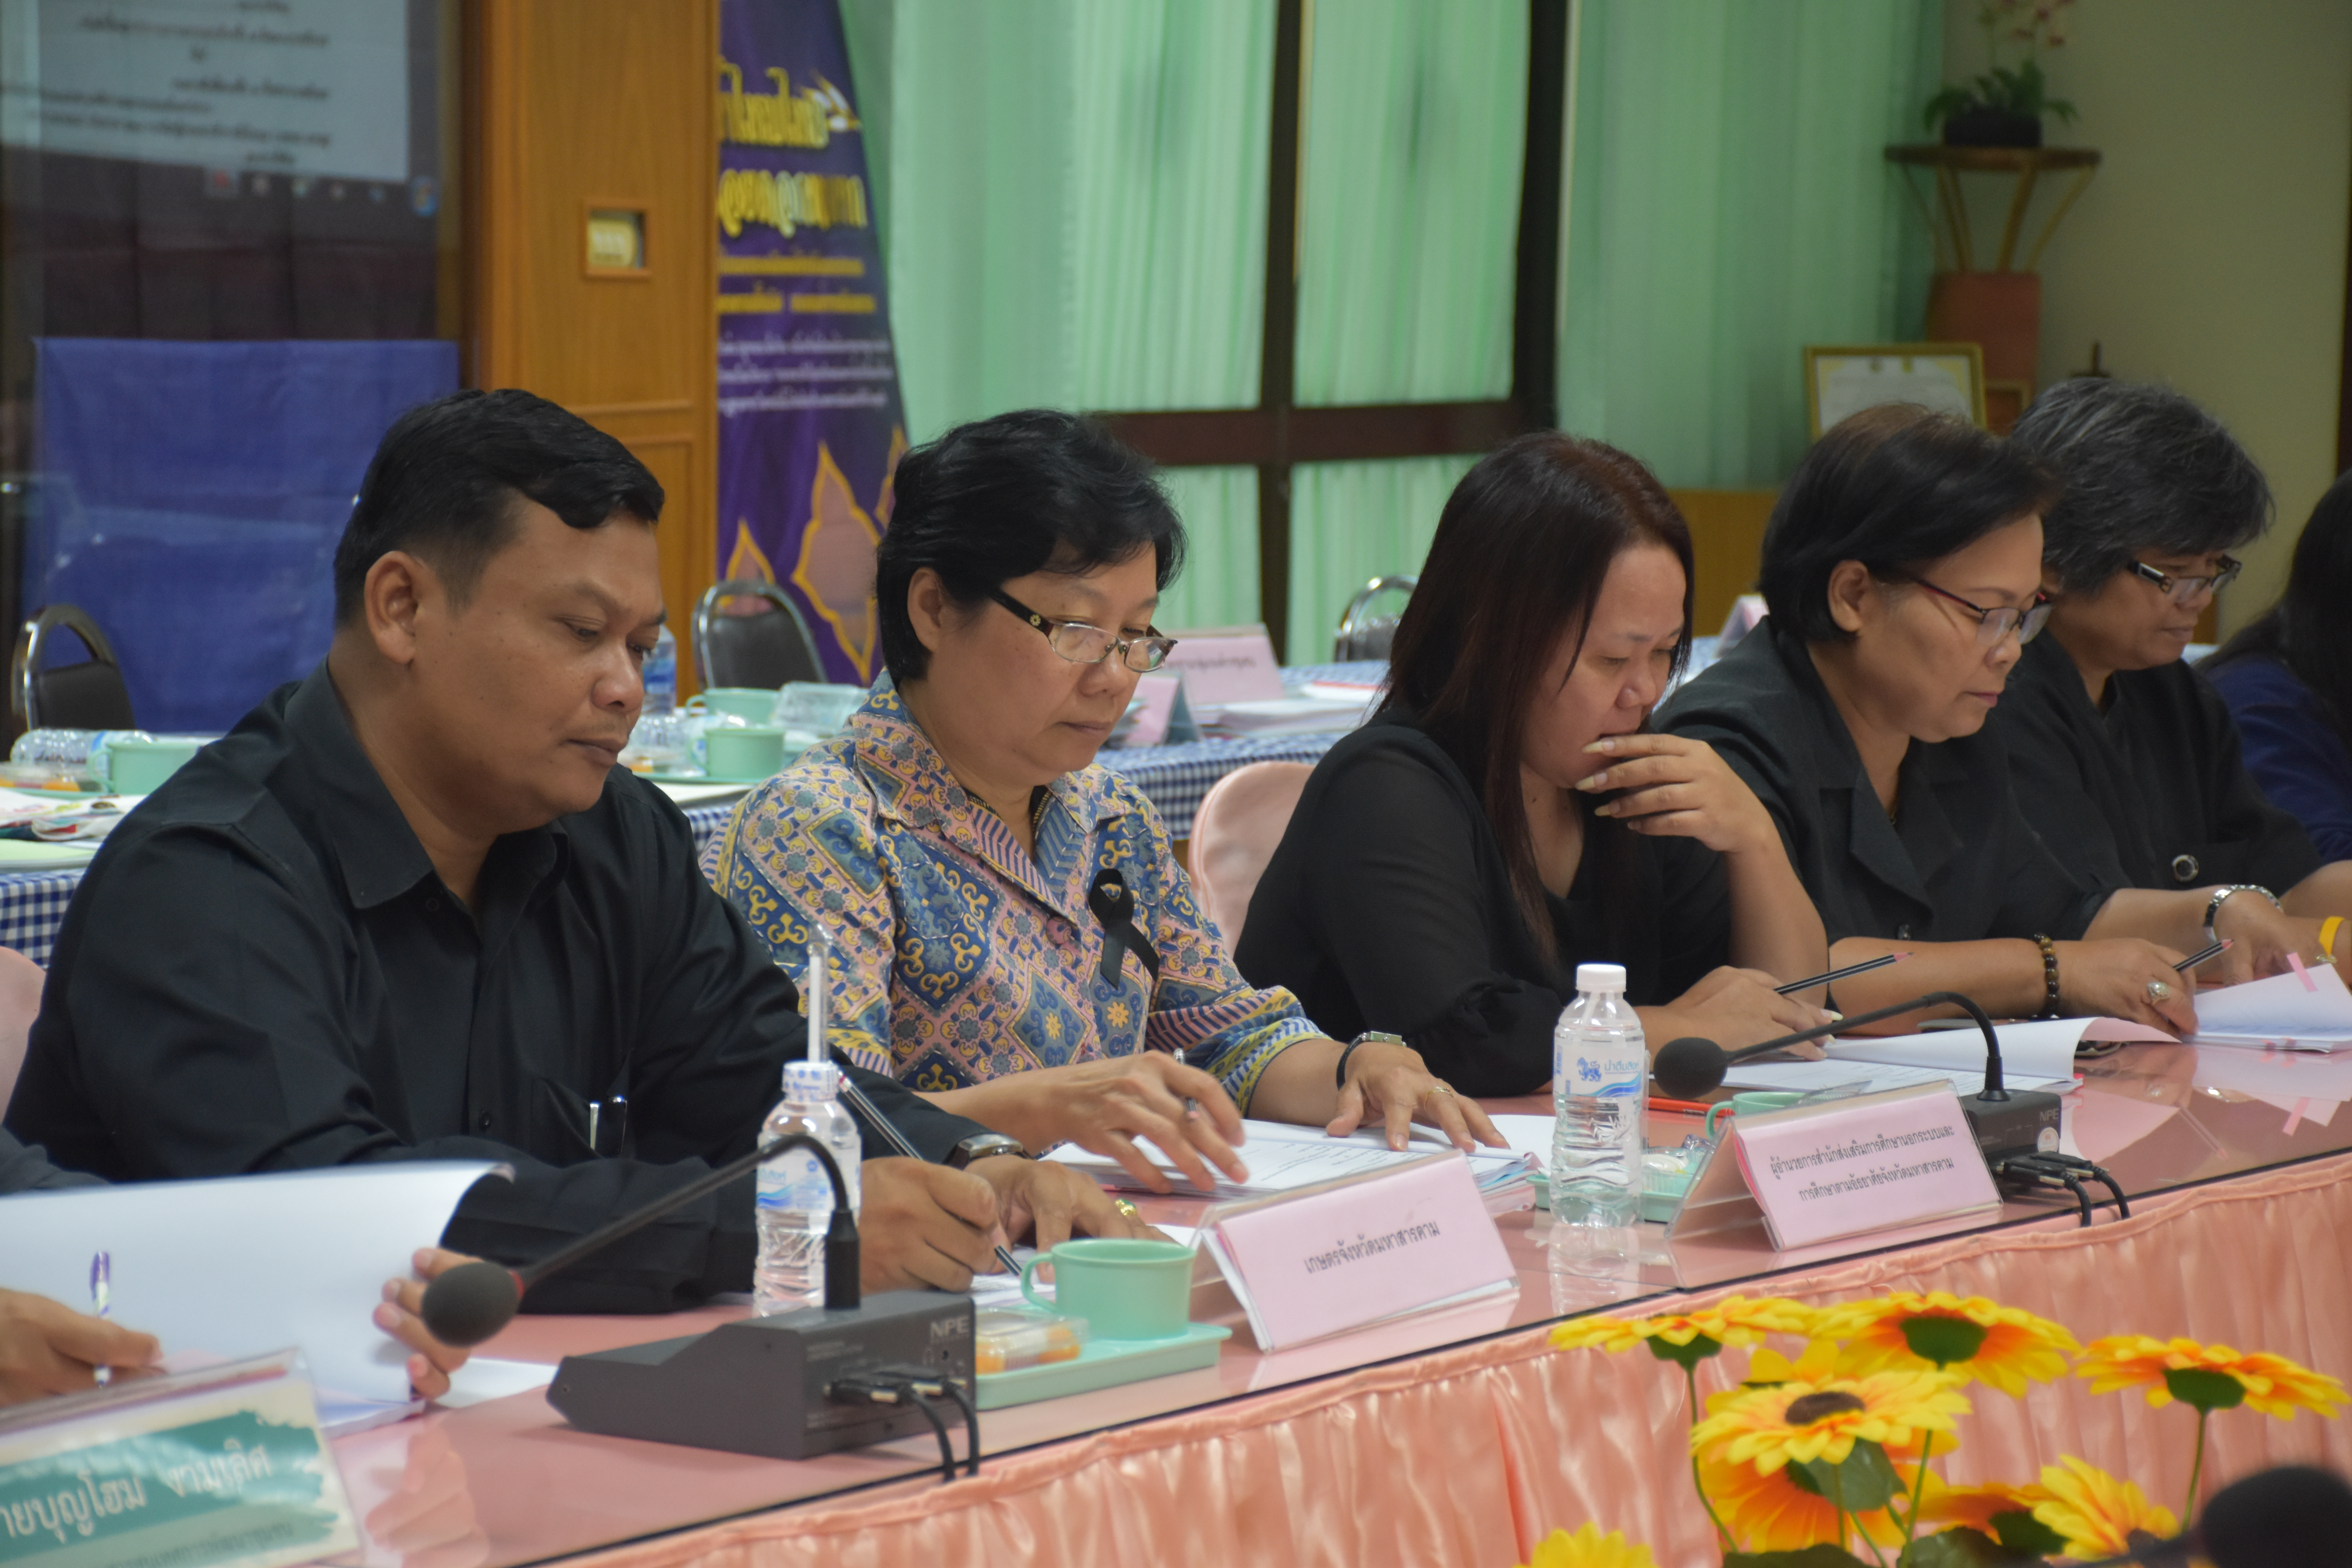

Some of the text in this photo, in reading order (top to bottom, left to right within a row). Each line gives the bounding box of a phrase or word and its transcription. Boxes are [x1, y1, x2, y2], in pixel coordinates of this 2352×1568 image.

[2040, 1109, 2059, 1122] NPE
[1770, 1125, 1955, 1180] ผู้อำนวยการสำนักส่งเสริมการศึกษานอกระบบและ
[1799, 1157, 1955, 1201] การศึกษาตามอัธยาศัยจังหวัดมหาสารคาม
[1304, 1221, 1441, 1274] เกษตรจังหวัดมหาสารคาม
[930, 1315, 969, 1338] NPE
[0, 1469, 147, 1544] ายบุญโฮม
